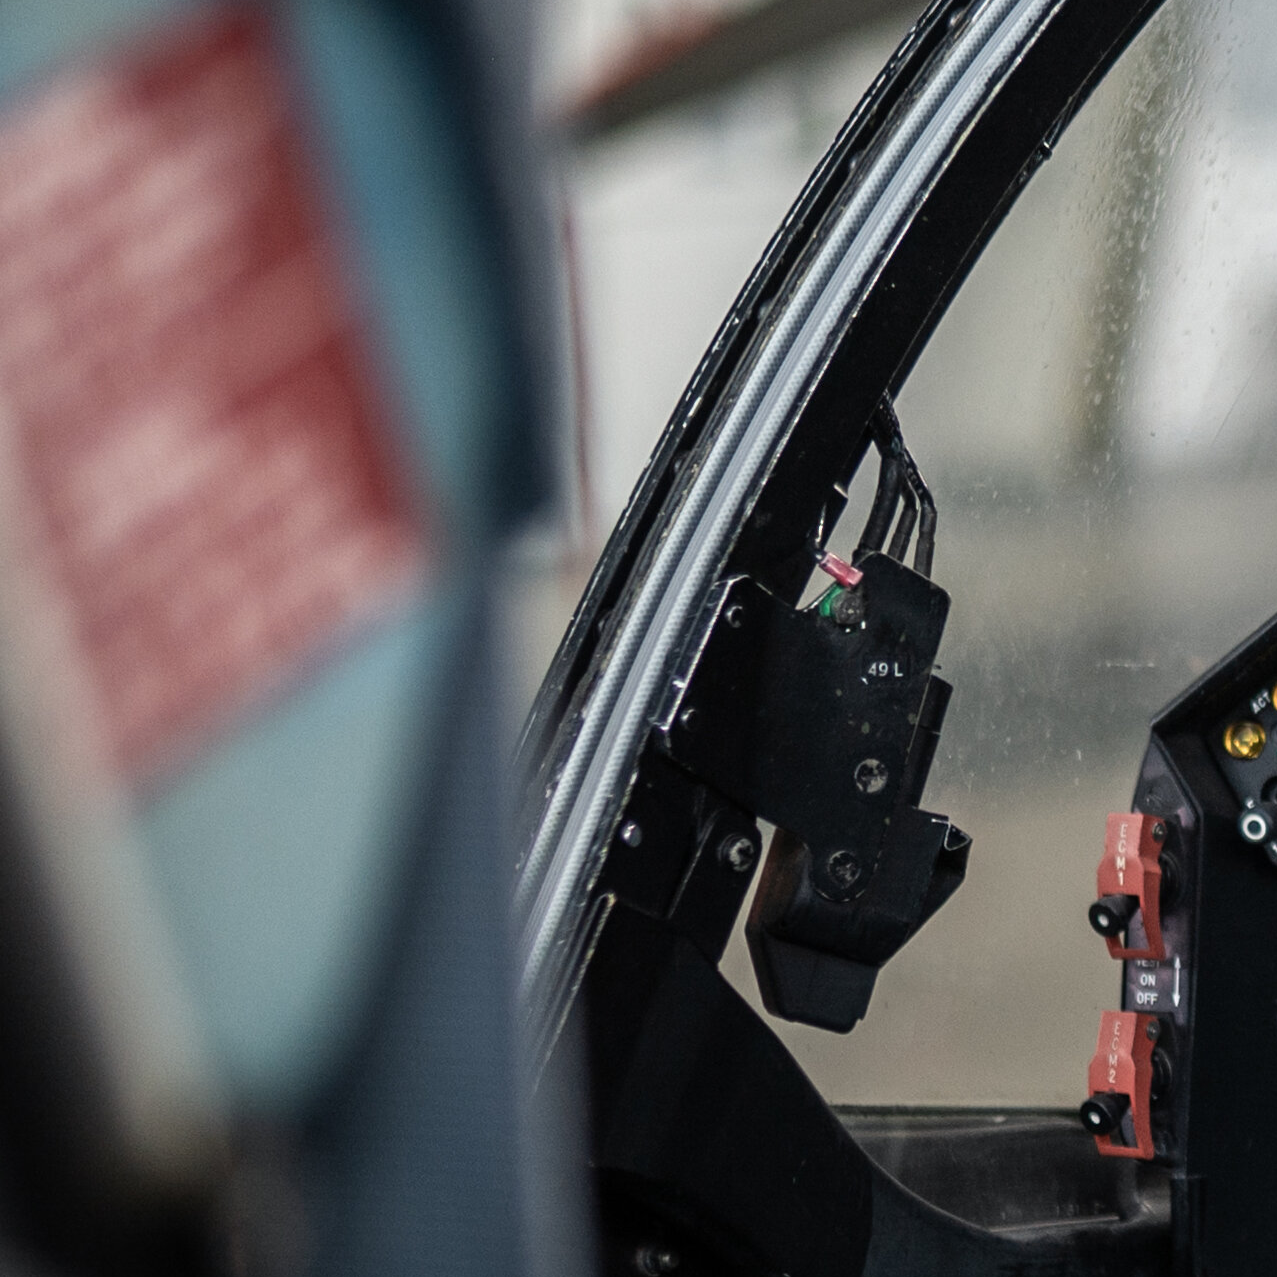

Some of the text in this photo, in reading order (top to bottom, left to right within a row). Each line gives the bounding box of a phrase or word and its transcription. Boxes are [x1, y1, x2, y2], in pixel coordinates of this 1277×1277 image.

[868, 662, 888, 677] 49
[1251, 689, 1271, 714] ACT
[1140, 974, 1155, 986] ON
[1137, 992, 1158, 1005] OFF
